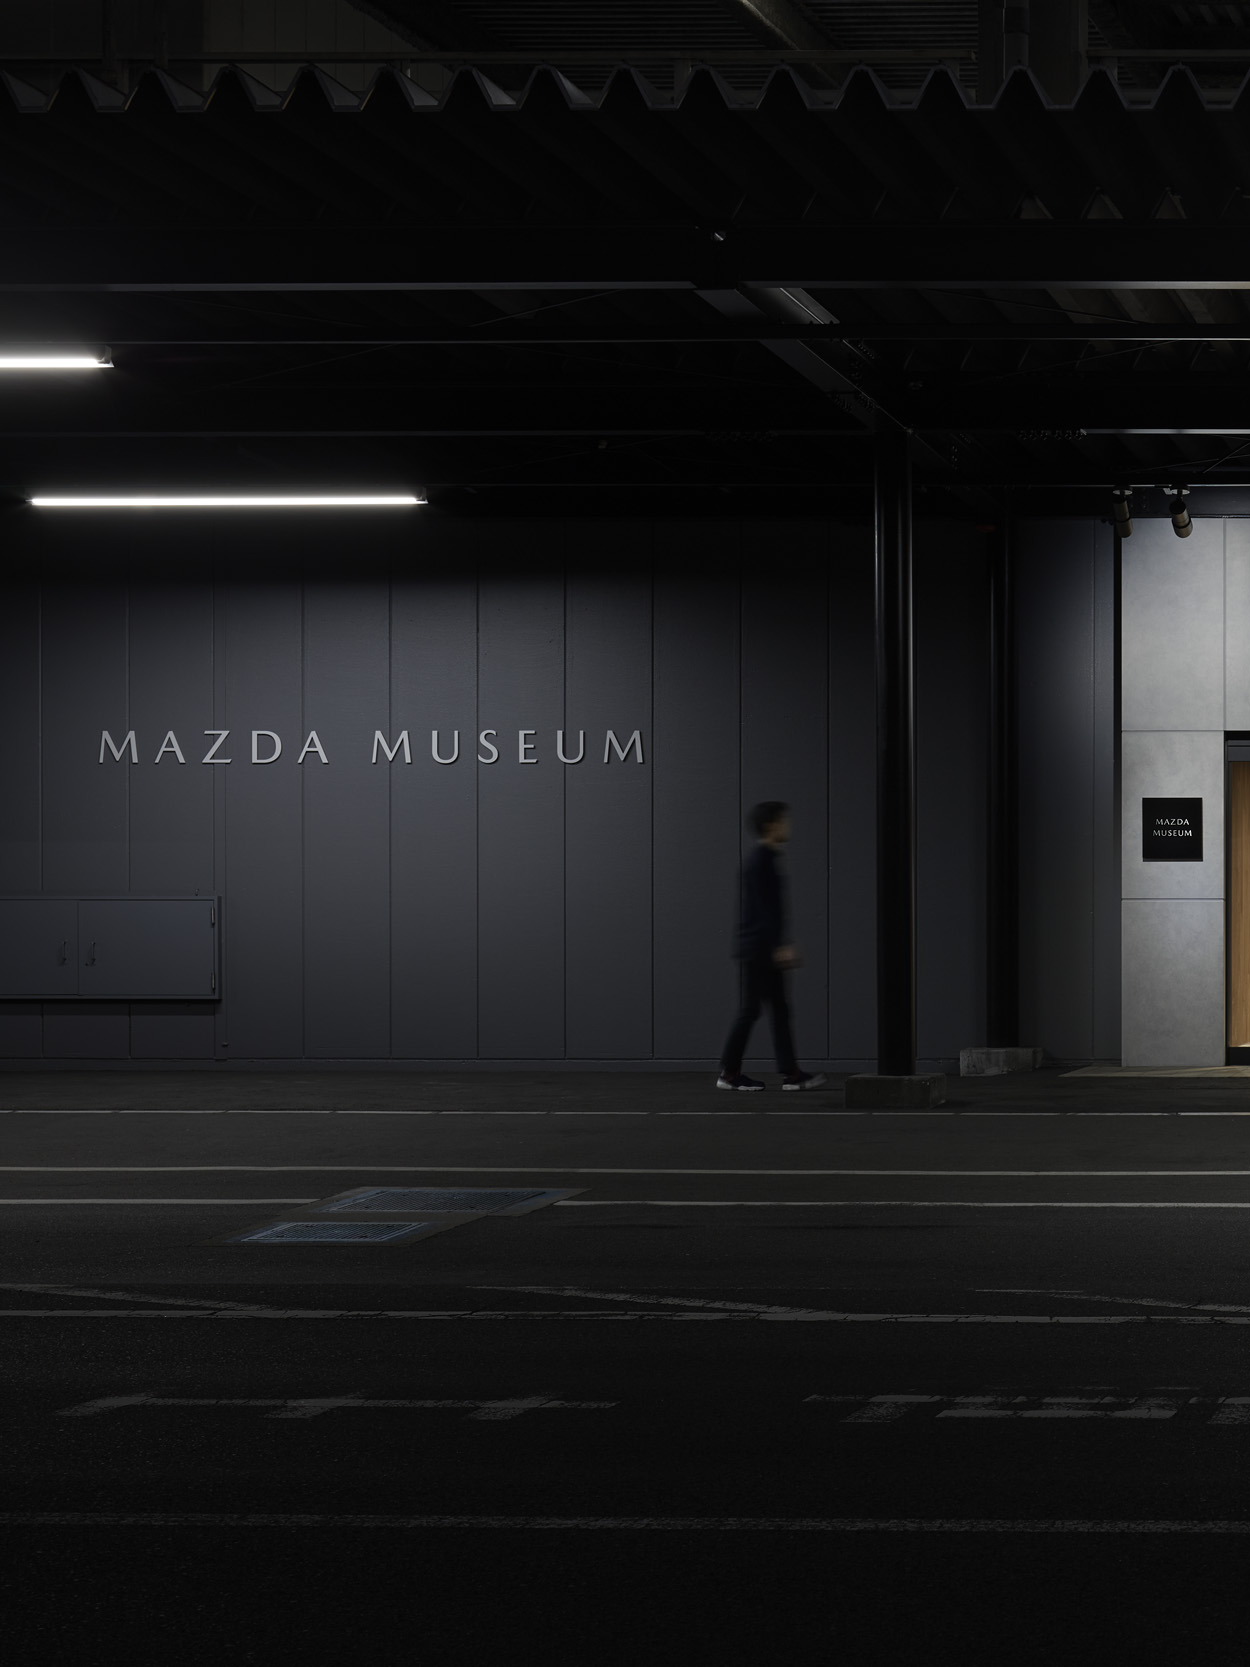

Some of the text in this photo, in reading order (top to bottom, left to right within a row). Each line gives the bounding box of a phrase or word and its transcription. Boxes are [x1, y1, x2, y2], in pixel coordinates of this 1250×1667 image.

[98, 730, 645, 764] MAZDA MUSEUM
[1155, 818, 1190, 826] MAZDA
[1152, 829, 1193, 837] MUSEUM
